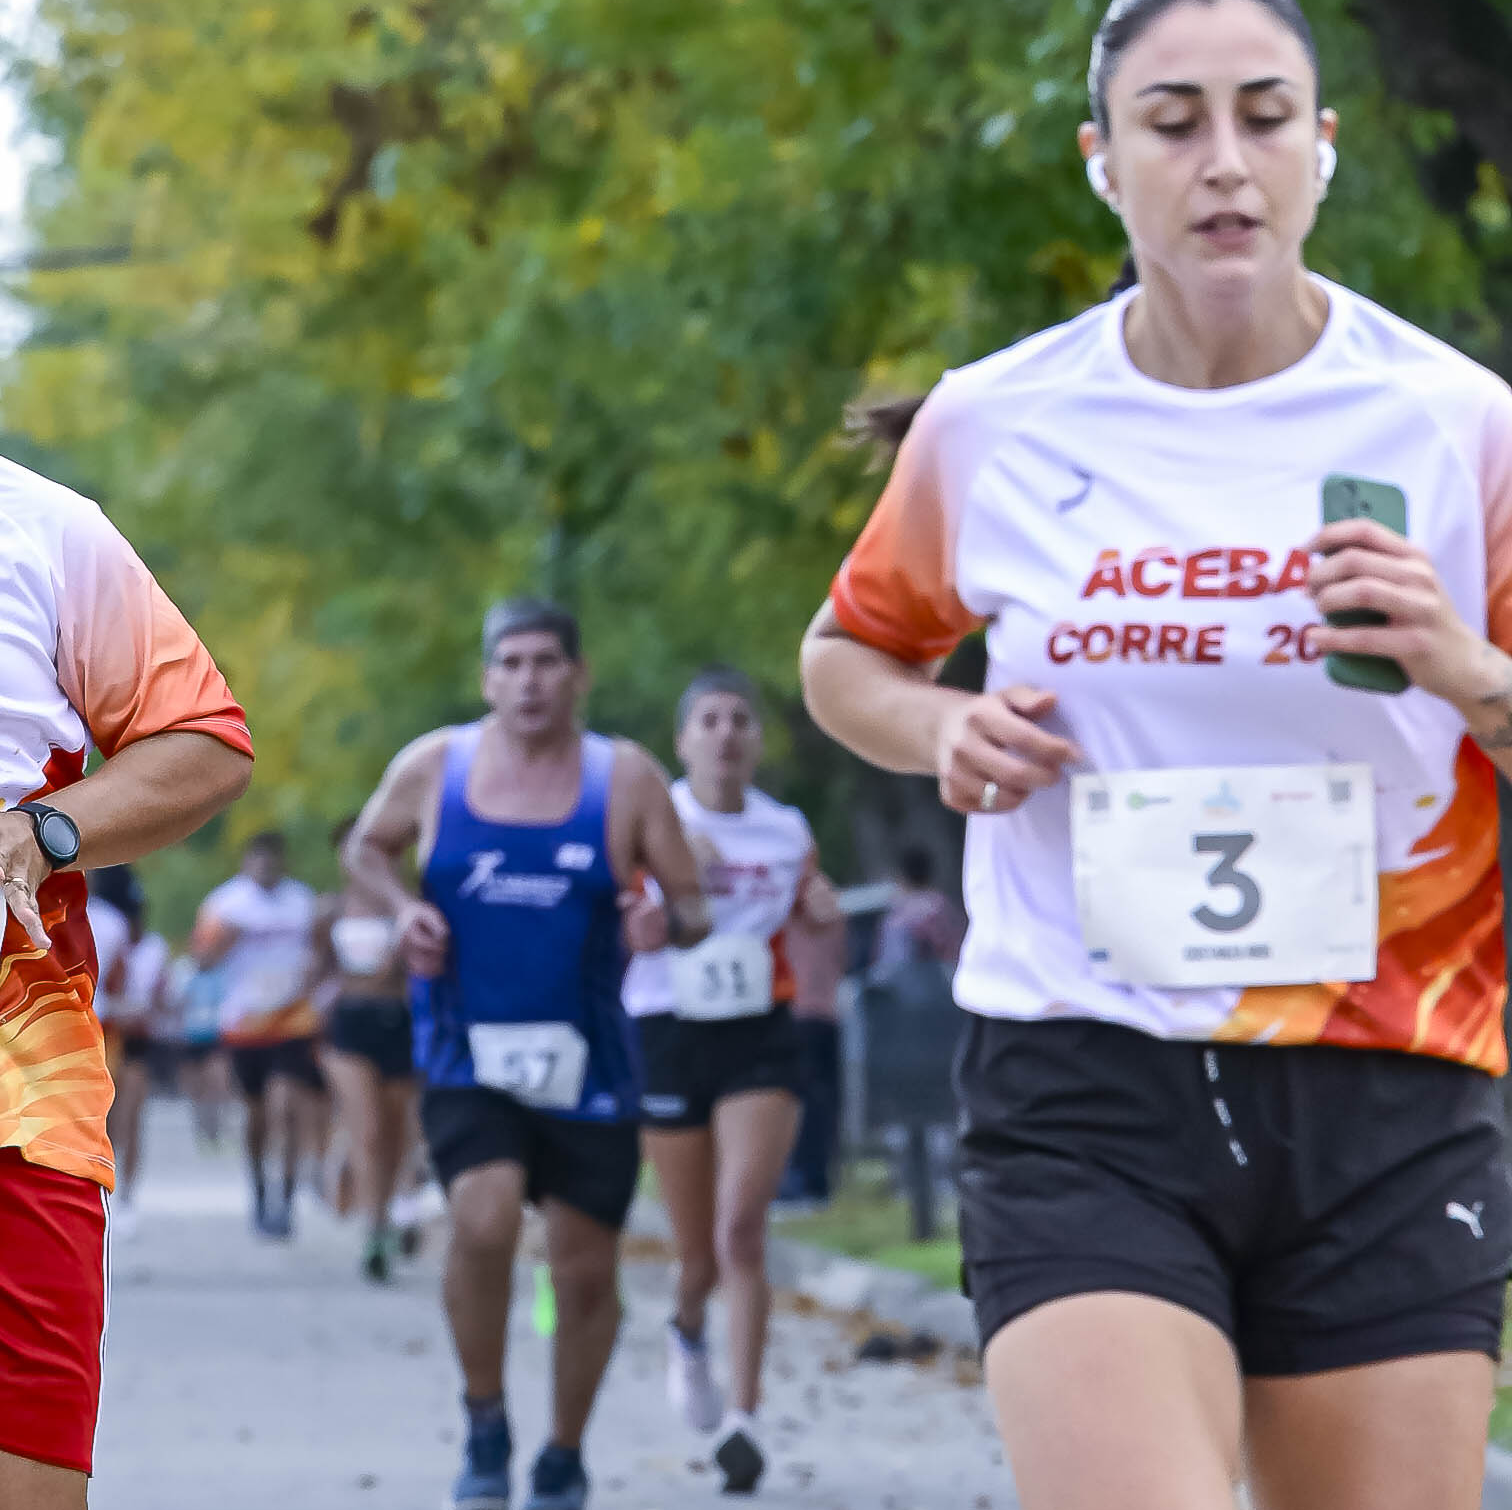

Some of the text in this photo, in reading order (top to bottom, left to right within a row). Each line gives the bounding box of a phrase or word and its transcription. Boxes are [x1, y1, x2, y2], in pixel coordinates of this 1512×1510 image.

[1082, 547, 1311, 598] ACEBA
[1048, 622, 1322, 664] CORRE 20
[1191, 833, 1262, 932] 3
